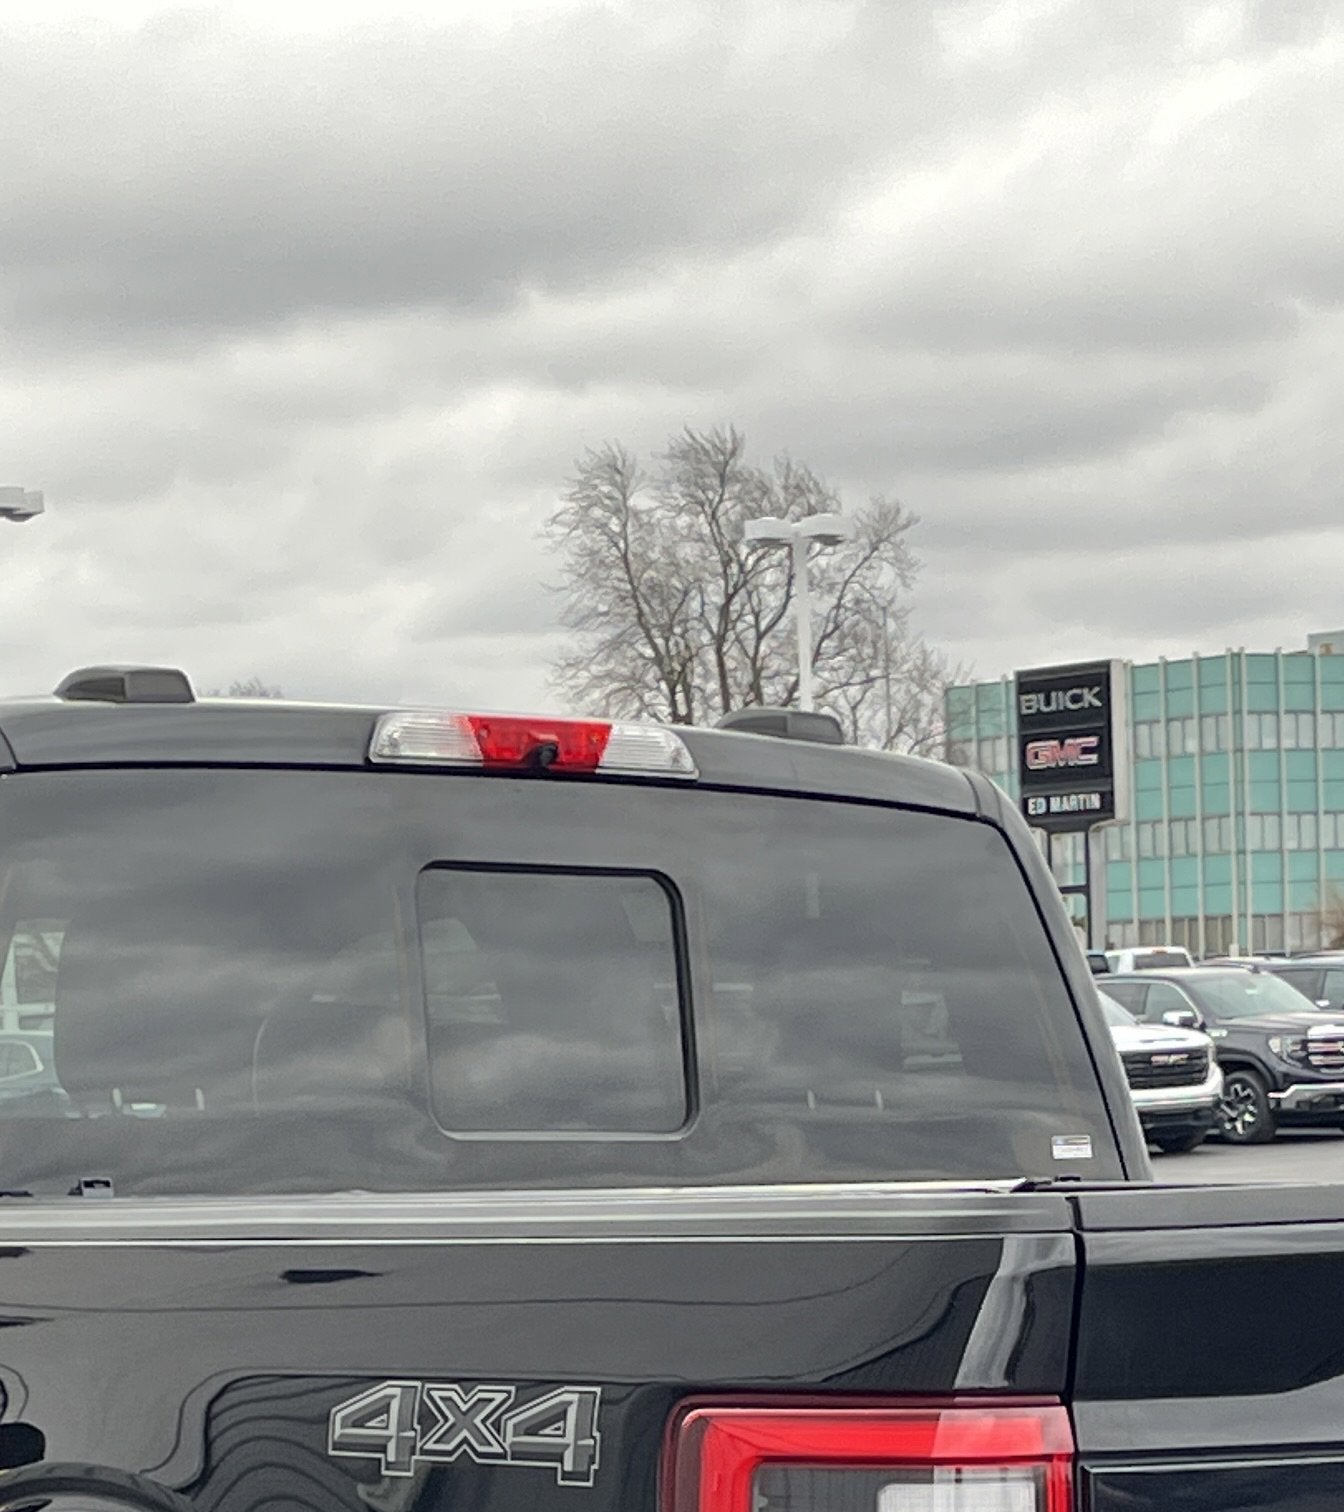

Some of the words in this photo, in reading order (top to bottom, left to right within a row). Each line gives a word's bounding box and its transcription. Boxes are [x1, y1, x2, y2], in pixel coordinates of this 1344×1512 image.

[1020, 686, 1103, 715] BUICK
[1026, 736, 1099, 770] GMC
[1028, 797, 1047, 815] ED
[1050, 792, 1101, 813] MARTIN
